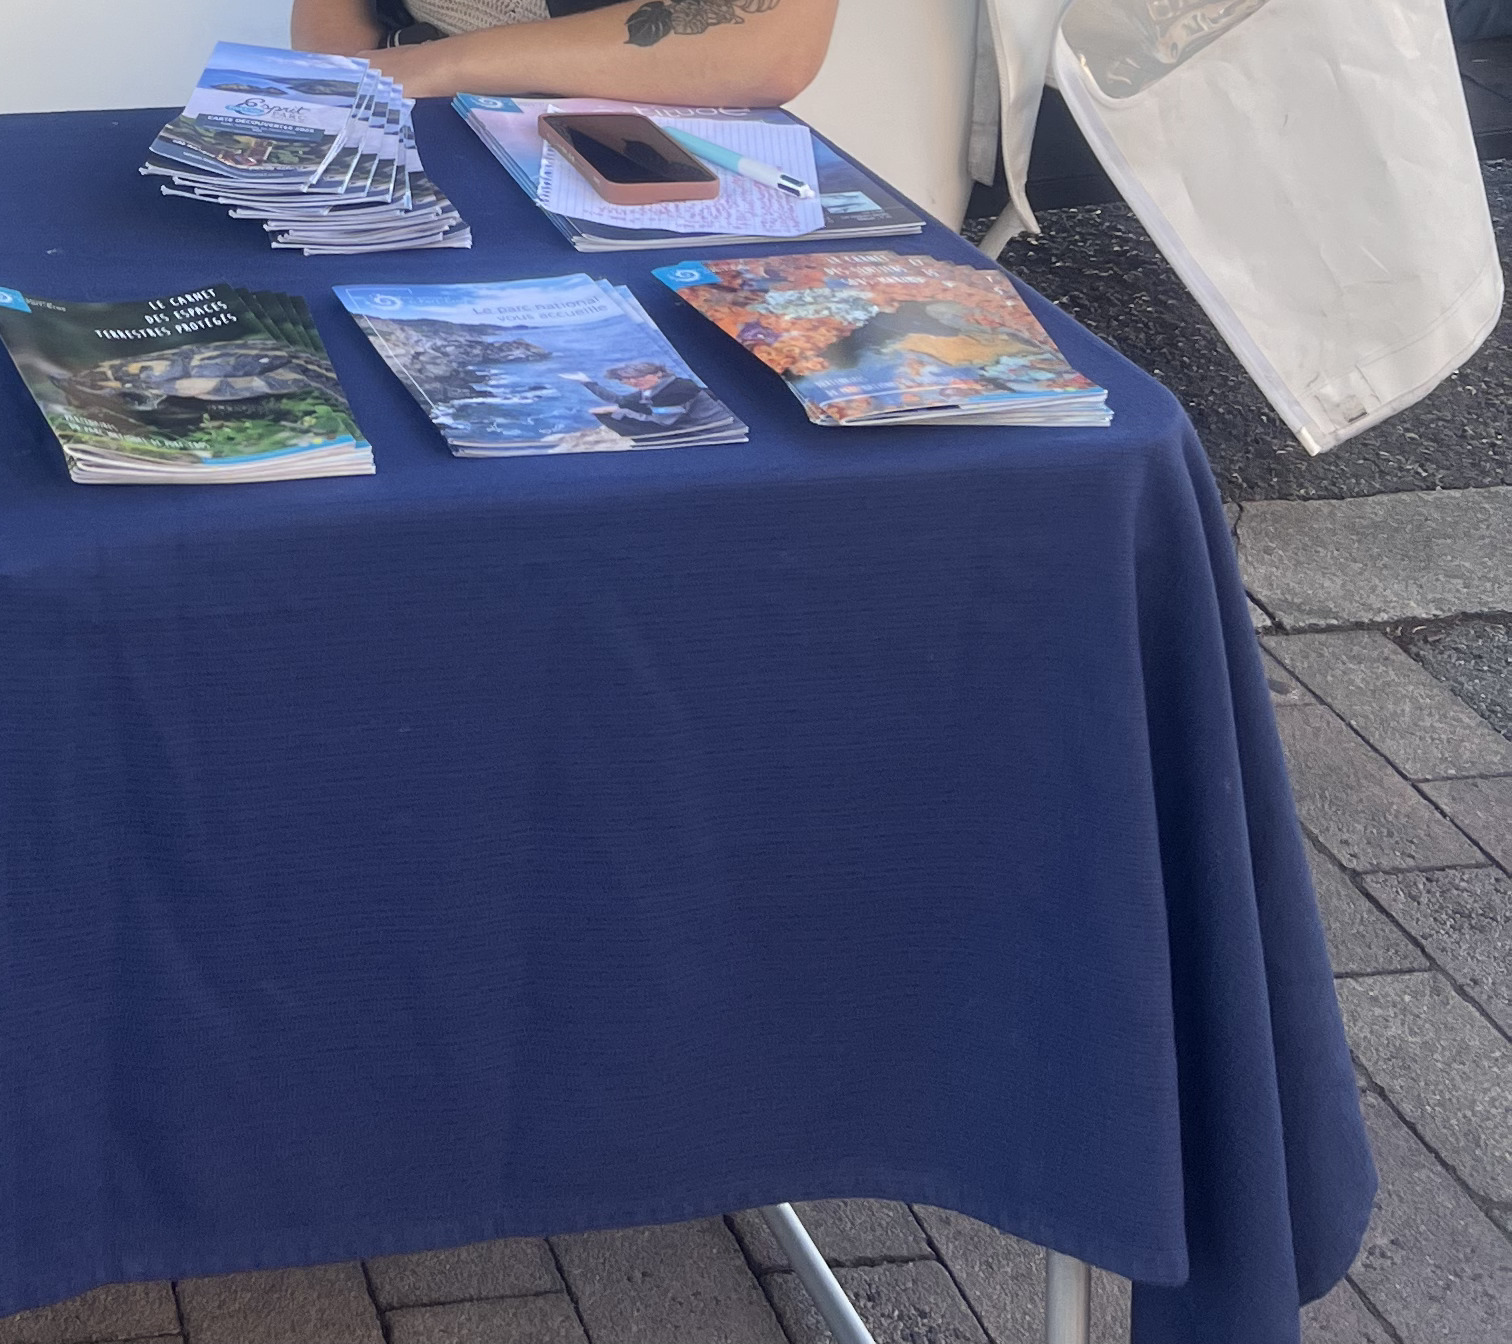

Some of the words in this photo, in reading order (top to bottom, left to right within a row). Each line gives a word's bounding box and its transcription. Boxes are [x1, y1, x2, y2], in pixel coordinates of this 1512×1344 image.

[237, 97, 311, 116] Esprit
[148, 300, 166, 312] LE
[170, 287, 217, 307] CARNET
[473, 306, 492, 316] Le
[496, 304, 526, 315] parc
[528, 295, 600, 312] national
[144, 312, 170, 325] DES
[173, 300, 228, 321] ESPACES
[496, 312, 537, 323] vous
[539, 303, 609, 321] accueille
[94, 325, 172, 341] TERRESTRES
[174, 312, 238, 335] PROTÉGÉS
